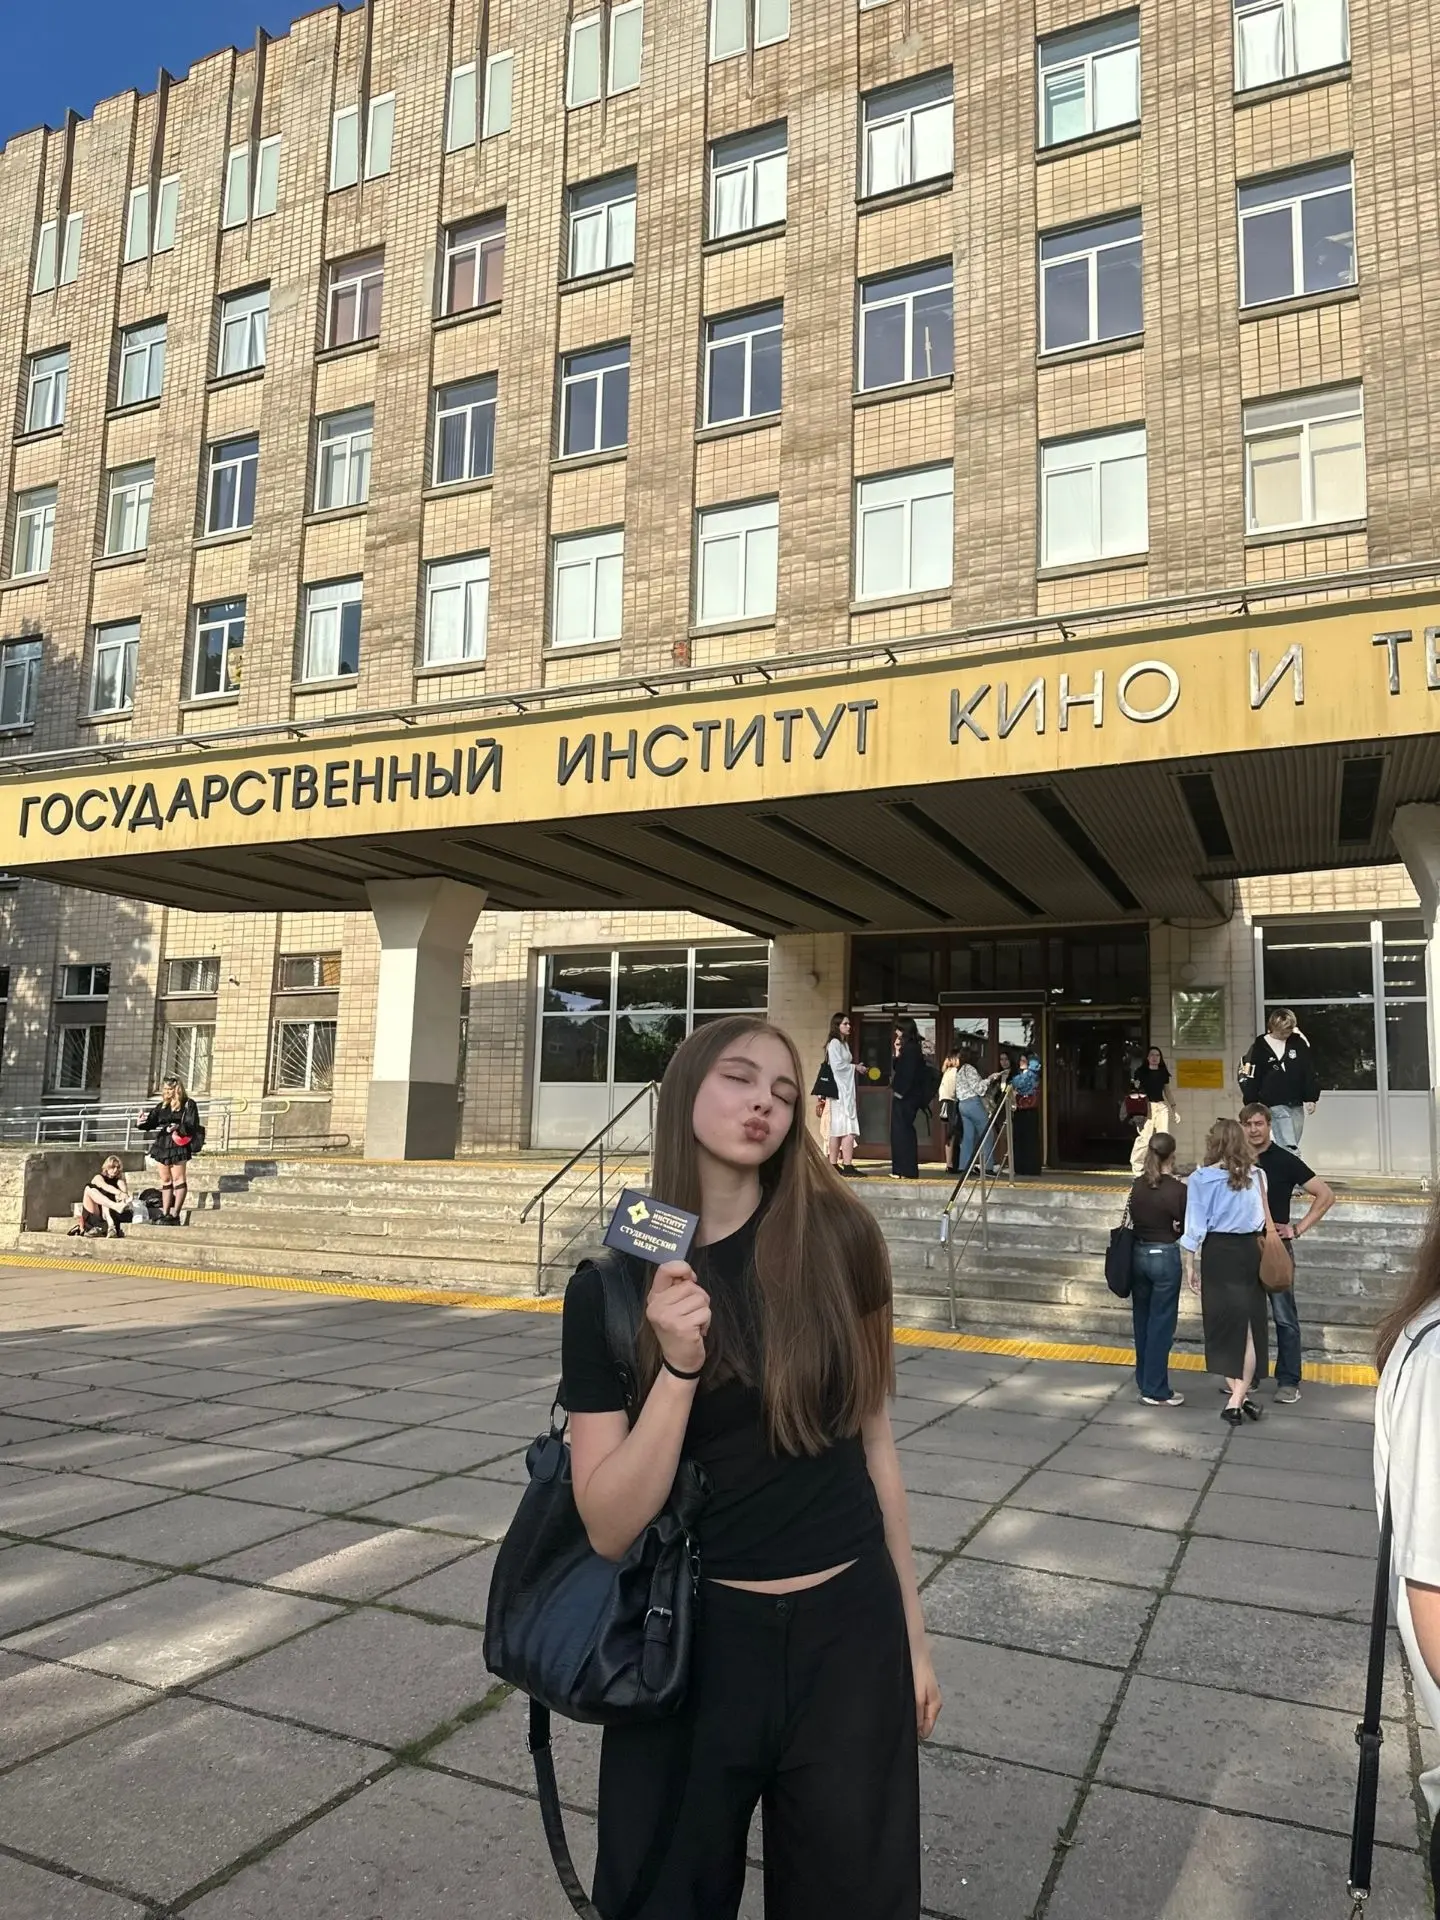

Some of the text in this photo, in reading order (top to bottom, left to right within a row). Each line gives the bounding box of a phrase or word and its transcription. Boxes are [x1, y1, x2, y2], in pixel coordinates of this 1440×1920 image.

[18, 738, 501, 837] ГОСУДАРСТВЕННЫЙ
[556, 698, 878, 785] ИНСТИТУТ
[949, 659, 1181, 743] КИНО
[1248, 643, 1305, 710] И
[652, 1213, 687, 1230] ИНСТИТУТ
[620, 1225, 677, 1252] СТУДЕНЧЕСКИЙ
[633, 1238, 658, 1253] БИЛЕТ
